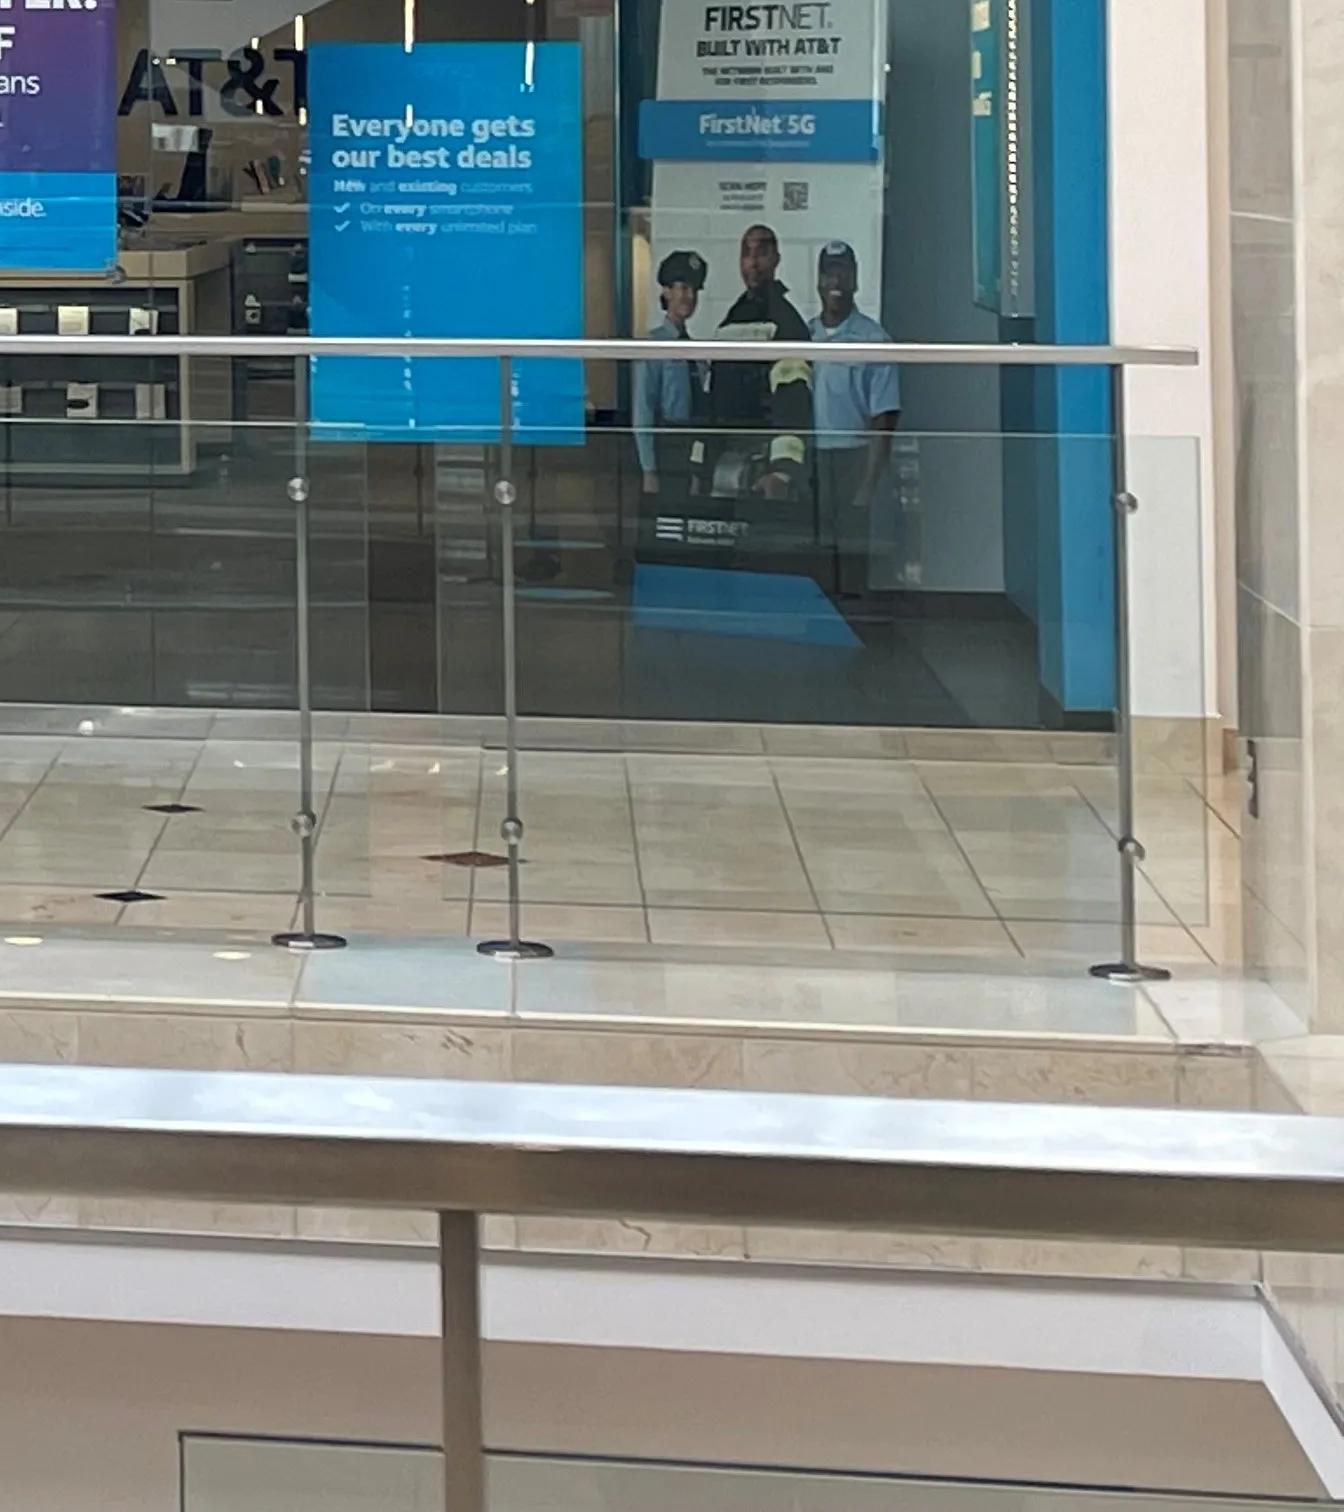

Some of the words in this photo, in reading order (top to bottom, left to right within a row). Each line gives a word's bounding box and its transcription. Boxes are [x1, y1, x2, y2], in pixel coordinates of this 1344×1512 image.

[695, 39, 742, 58] BUILT
[745, 38, 790, 57] WITH
[794, 36, 843, 56] AT&T
[116, 48, 308, 117] AT&T
[331, 113, 465, 144] Everyone
[471, 115, 536, 144] gets
[699, 114, 784, 135] FirstNet
[787, 114, 816, 135] 5G
[331, 149, 381, 169] our
[387, 144, 451, 169] best
[457, 144, 533, 169] deals
